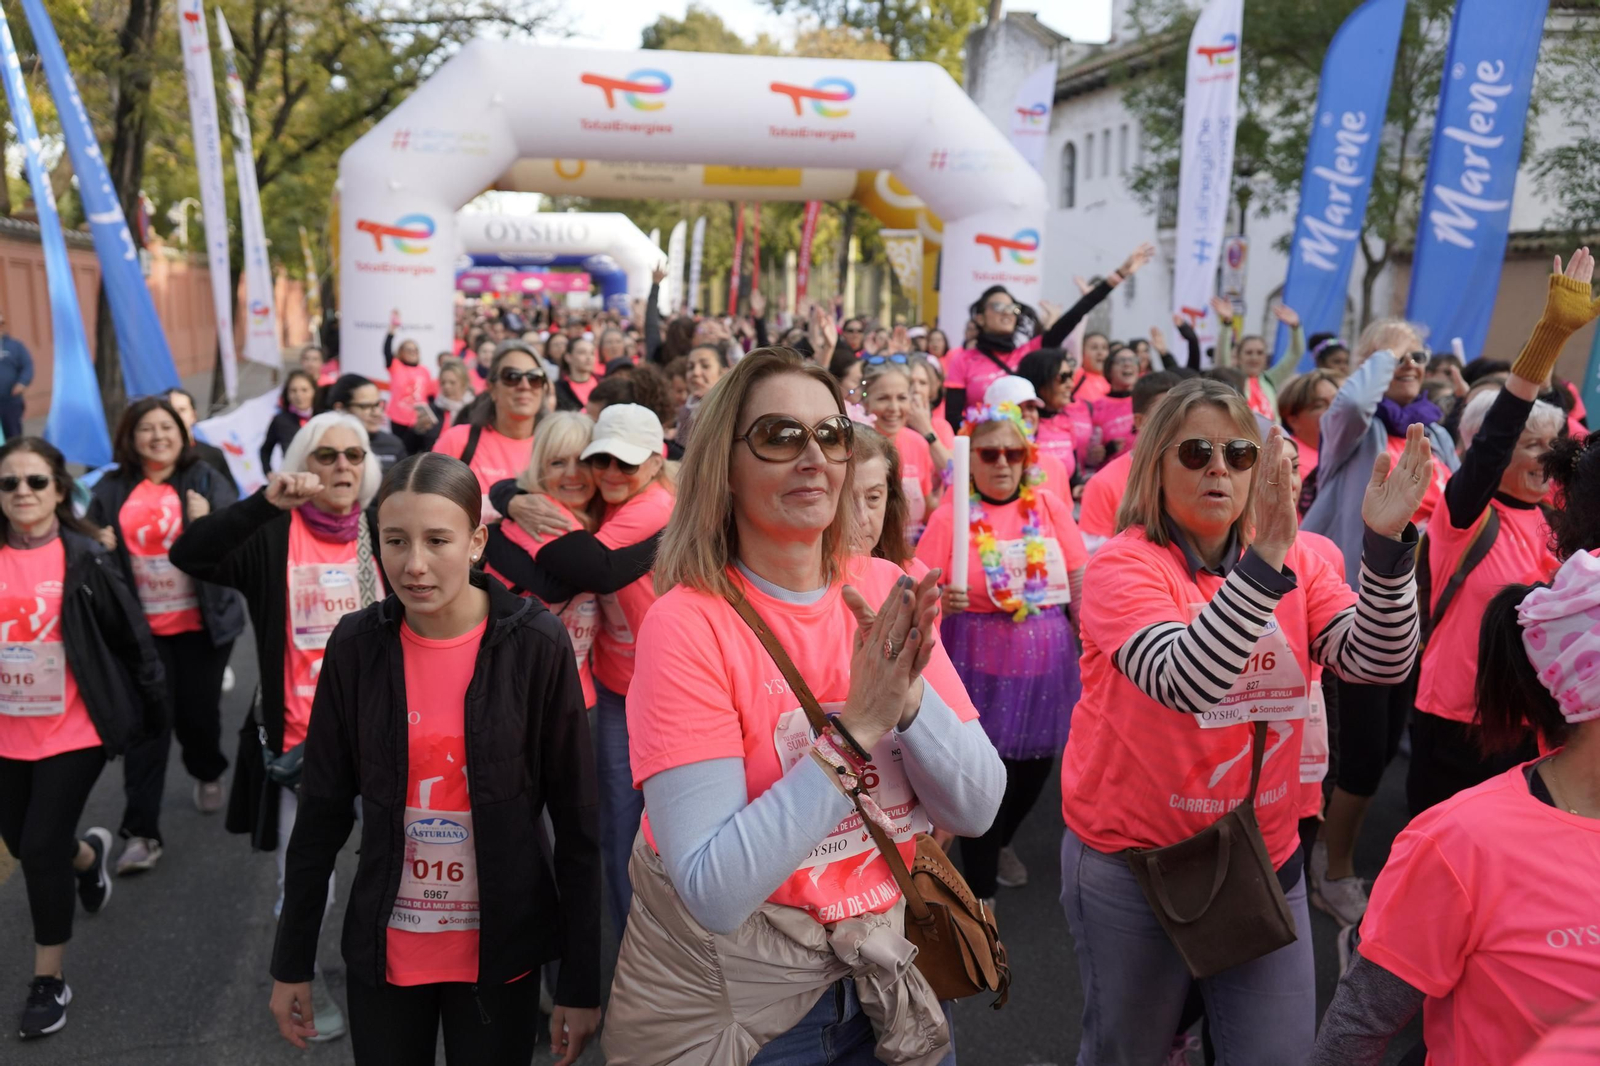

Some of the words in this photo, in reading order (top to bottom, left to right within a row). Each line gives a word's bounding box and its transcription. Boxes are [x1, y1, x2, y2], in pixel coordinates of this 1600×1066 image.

[580, 118, 673, 136] TotalEnergies
[768, 126, 856, 142] TotalEnergies
[1429, 59, 1513, 249] Marlene
[1298, 111, 1370, 271] Marlene
[484, 220, 590, 244] OYSHO
[325, 597, 357, 612] 016
[2, 672, 35, 685] 016
[1246, 681, 1260, 691] 827
[1270, 689, 1293, 697] SEVILLA
[1202, 708, 1239, 721] OYSHO
[1259, 704, 1295, 714] Santander
[786, 737, 810, 752] SUMA
[1169, 793, 1225, 814] CARRERA
[1259, 780, 1288, 807] MUJER
[840, 821, 849, 831] DE
[849, 818, 857, 828] LA
[411, 826, 465, 839] ASTURIANA
[412, 859, 464, 882] 016
[423, 889, 449, 900] 6967
[413, 901, 422, 909] DE
[433, 902, 456, 910] MUJER
[846, 895, 866, 917] DE
[862, 889, 881, 910] LA
